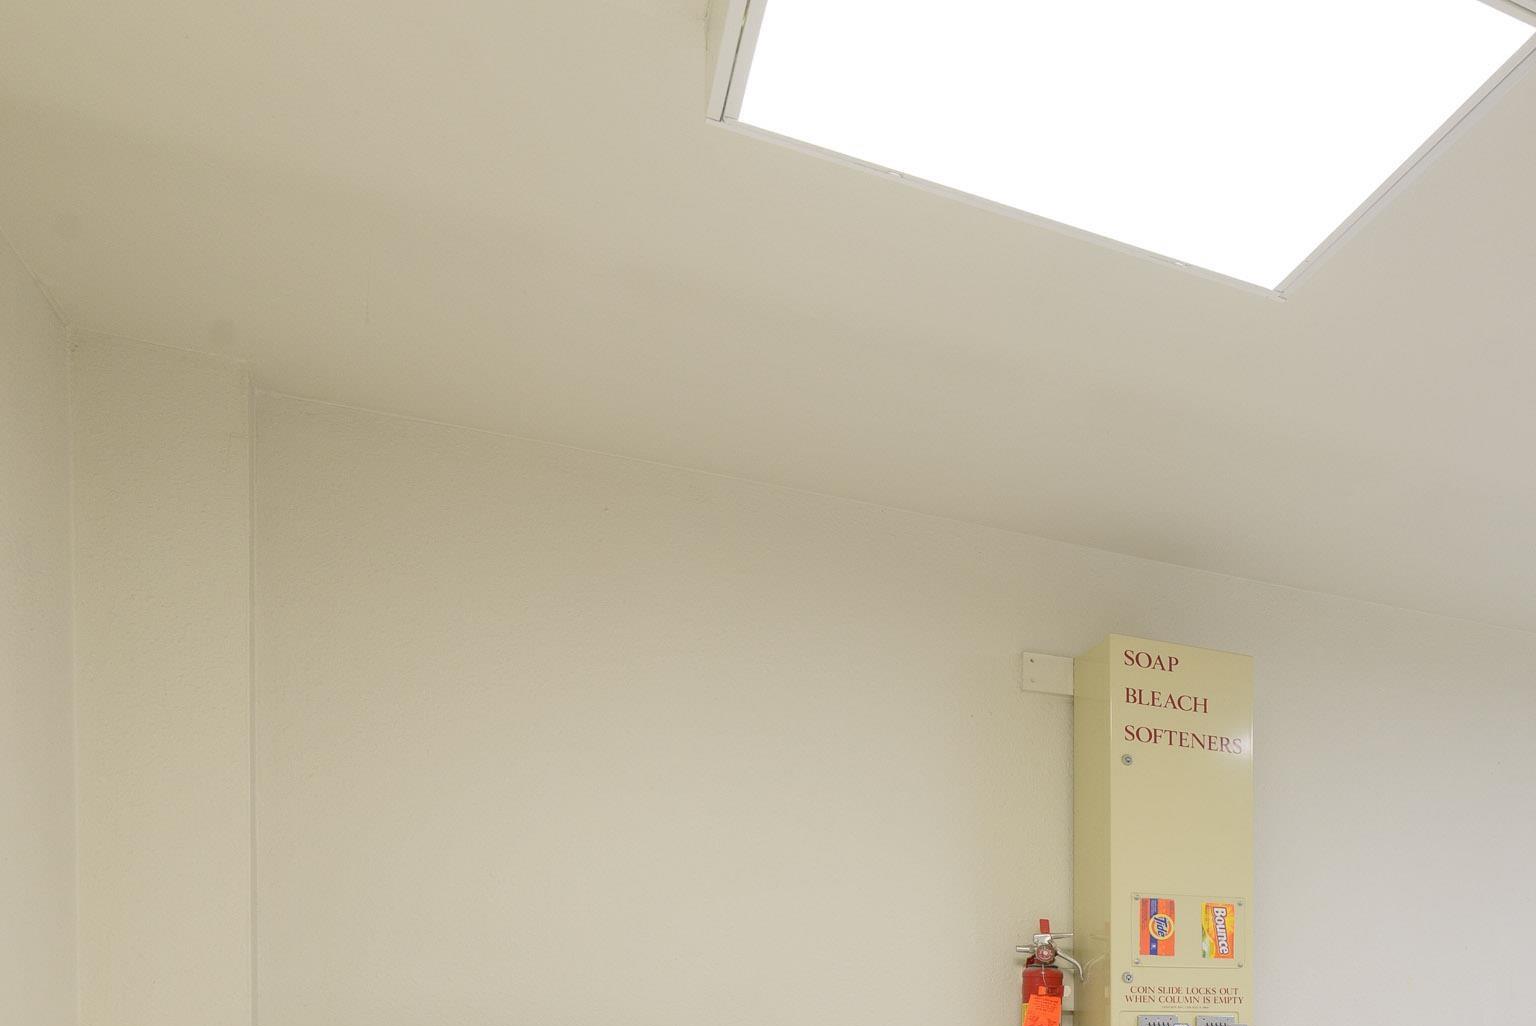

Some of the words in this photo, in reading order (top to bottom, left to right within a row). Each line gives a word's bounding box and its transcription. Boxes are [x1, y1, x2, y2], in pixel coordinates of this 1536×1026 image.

[1124, 650, 1179, 672] SOAP
[1125, 687, 1208, 714] BLEACH
[1124, 725, 1242, 754] SOFTENERS
[1154, 916, 1169, 938] Tide
[1213, 906, 1230, 955] Bounce
[1125, 994, 1156, 1003] WHEN
[1158, 995, 1199, 1004] COLUMN
[1203, 995, 1211, 1004] IS
[1214, 996, 1244, 1005] EMPTY
[1130, 985, 1156, 994] COIN
[1157, 986, 1182, 995] SLIDE
[1186, 986, 1217, 996] LOCKS
[1220, 987, 1240, 996] OUT
